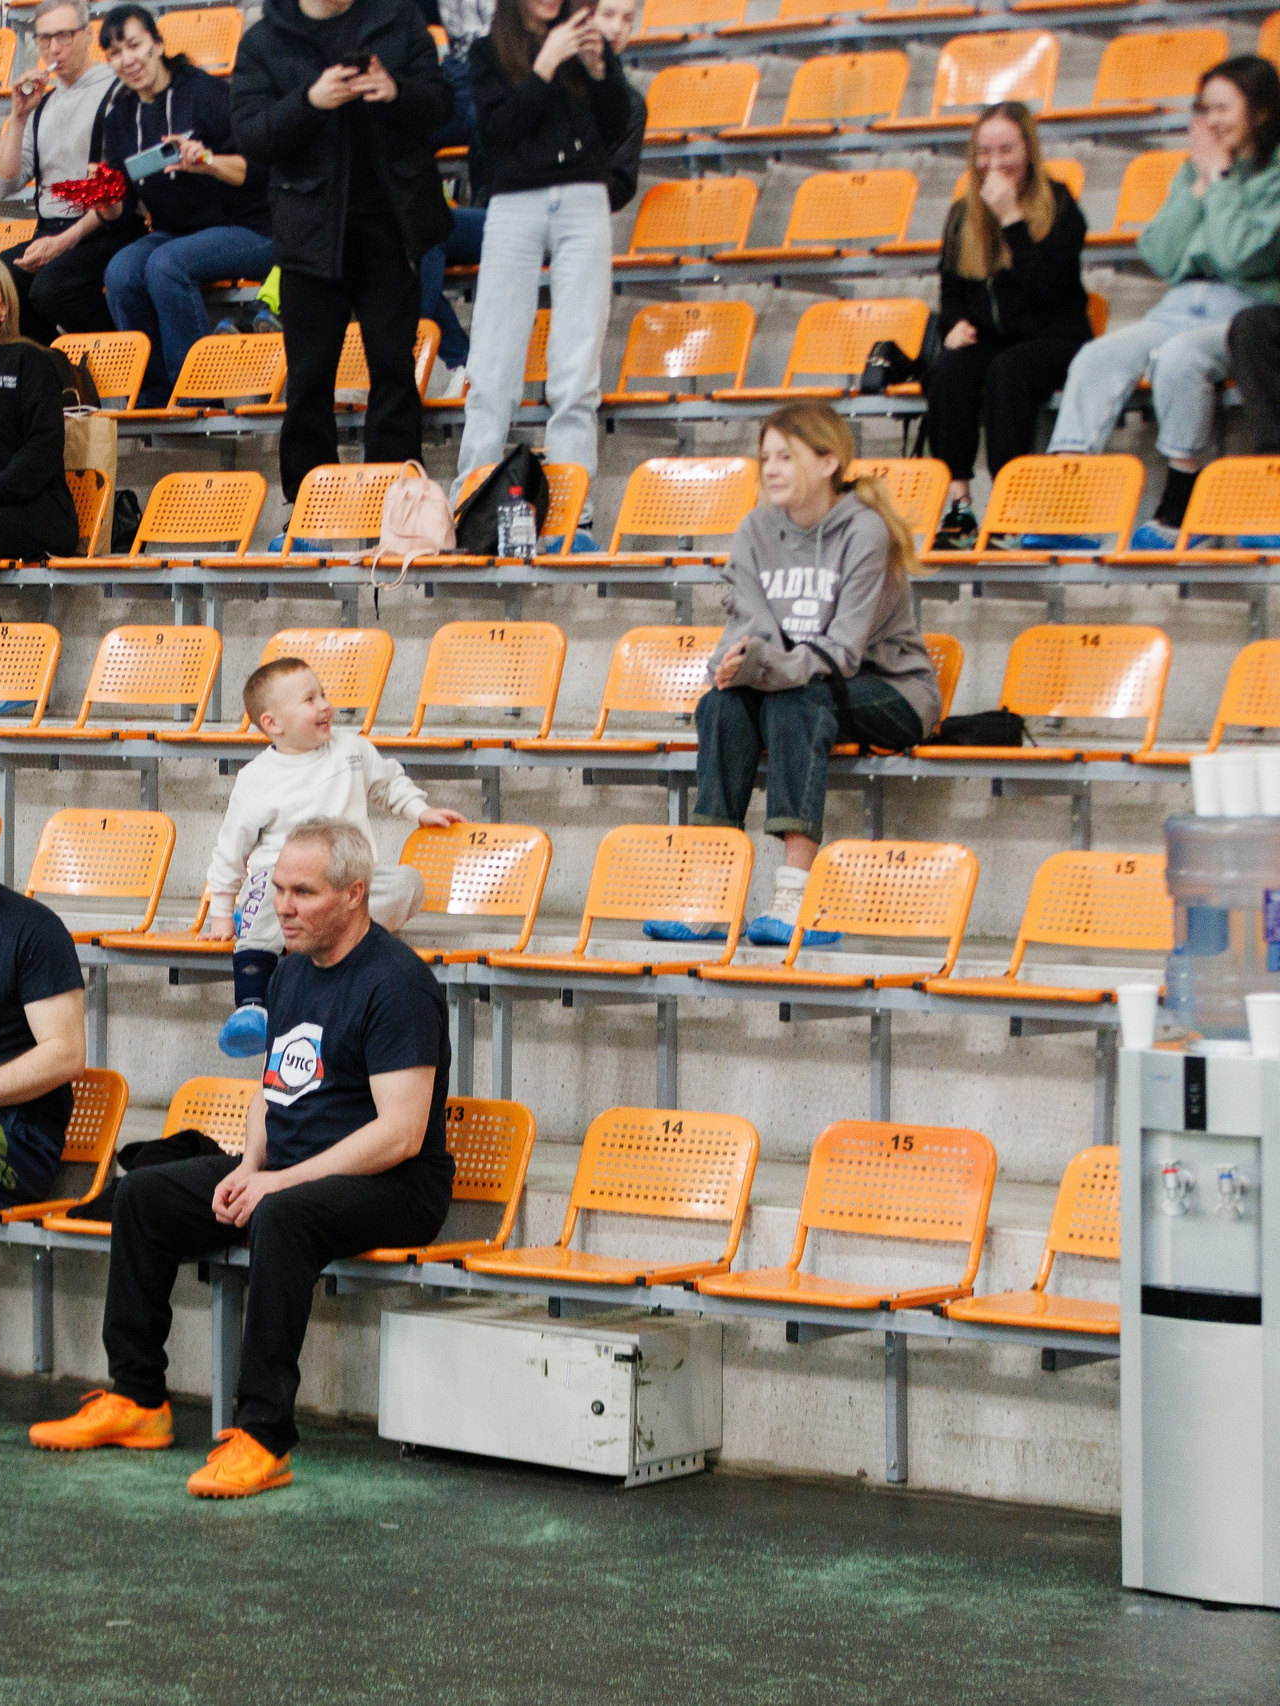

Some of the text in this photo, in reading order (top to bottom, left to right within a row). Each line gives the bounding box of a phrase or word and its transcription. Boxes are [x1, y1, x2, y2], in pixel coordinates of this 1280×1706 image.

[5, 225, 11, 233] 4
[94, 340, 101, 349] 6
[240, 340, 247, 349] 7
[357, 473, 363, 482] 9
[871, 467, 889, 478] 12
[205, 479, 212, 488] 8
[1, 625, 9, 636] 8
[489, 629, 505, 641] 11
[156, 634, 164, 644] 9
[322, 636, 337, 648] 10
[678, 636, 695, 647] 12
[1080, 634, 1100, 647] 14
[469, 832, 487, 845] 12
[886, 850, 906, 862] 14
[1116, 861, 1135, 873] 15
[446, 1106, 465, 1121] 13
[662, 1121, 683, 1134] 14
[891, 1135, 914, 1150] 15
